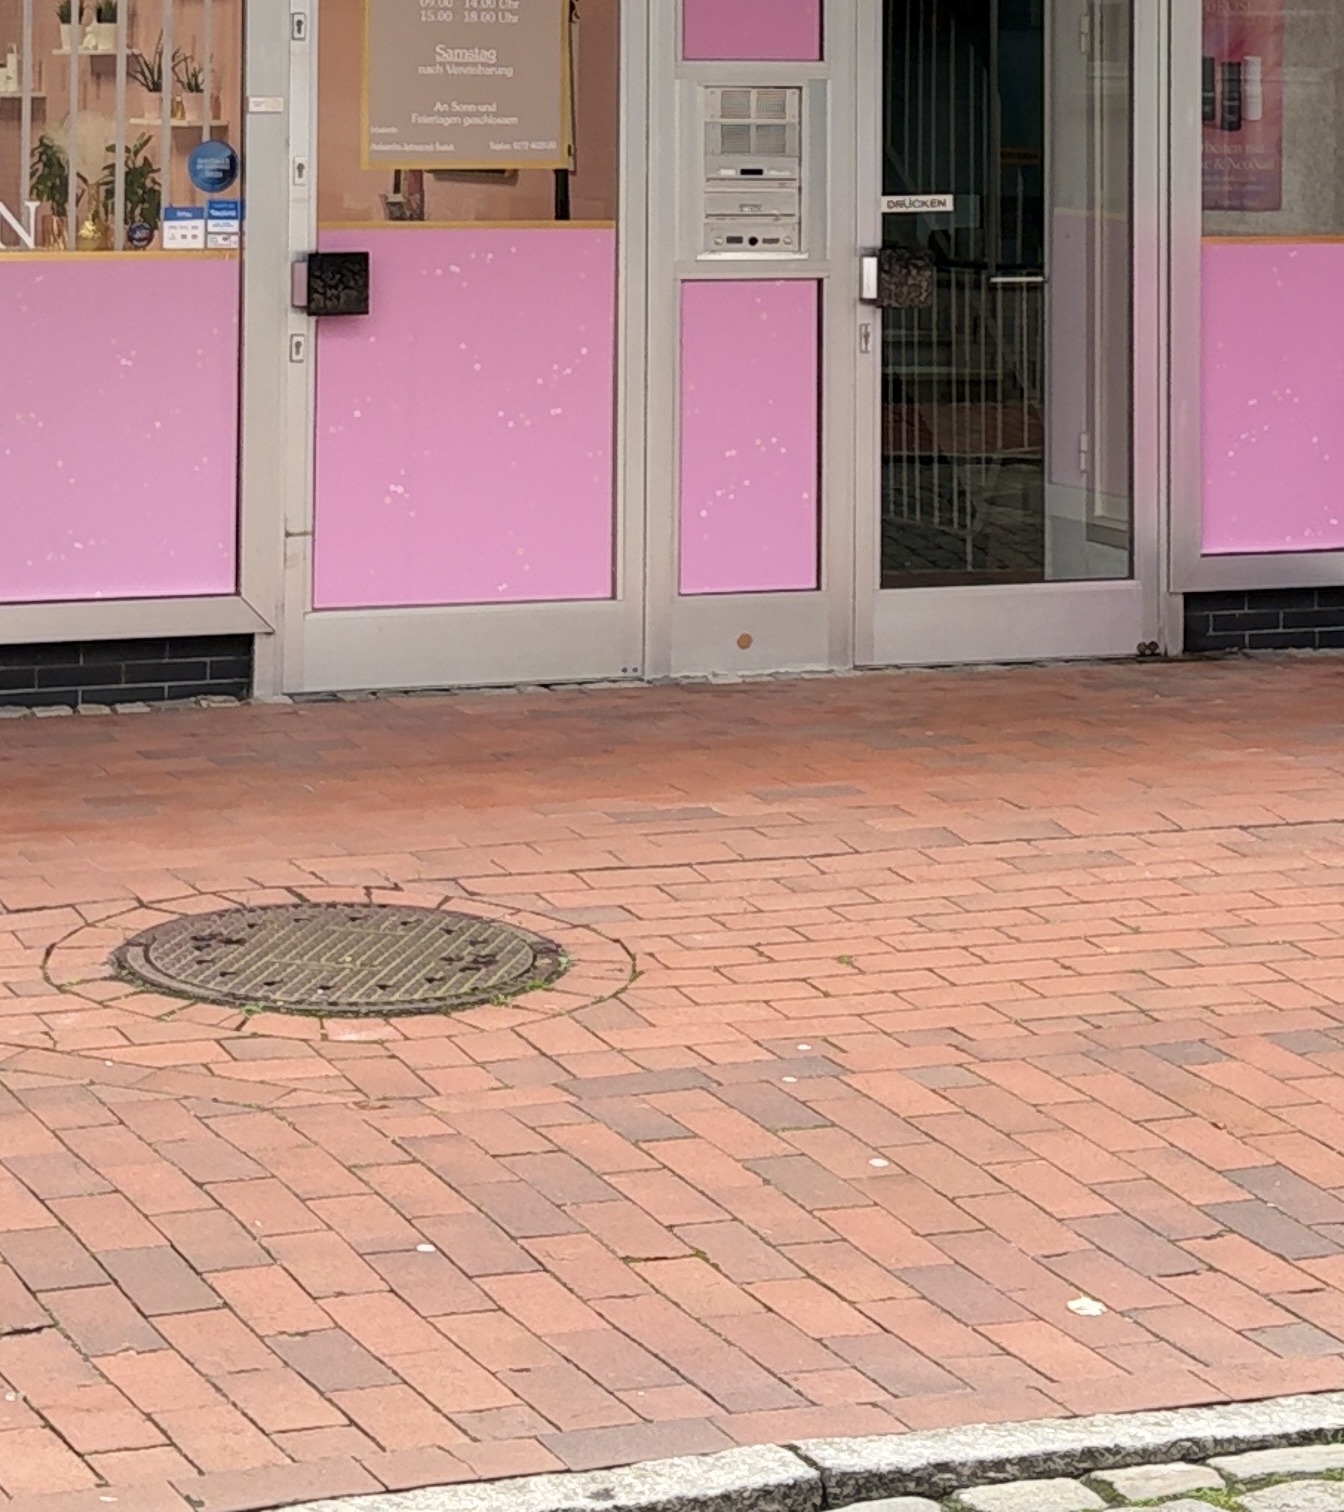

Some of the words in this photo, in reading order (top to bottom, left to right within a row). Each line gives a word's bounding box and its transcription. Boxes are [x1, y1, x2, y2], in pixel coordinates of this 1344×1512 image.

[498, 11, 520, 23] Uhr
[435, 44, 498, 63] Samstag
[417, 64, 444, 75] nach
[445, 64, 514, 77] Vereinbarung
[432, 101, 449, 112] An
[410, 113, 462, 127] Feiertagen
[886, 197, 948, 210] DRÜCKEN
